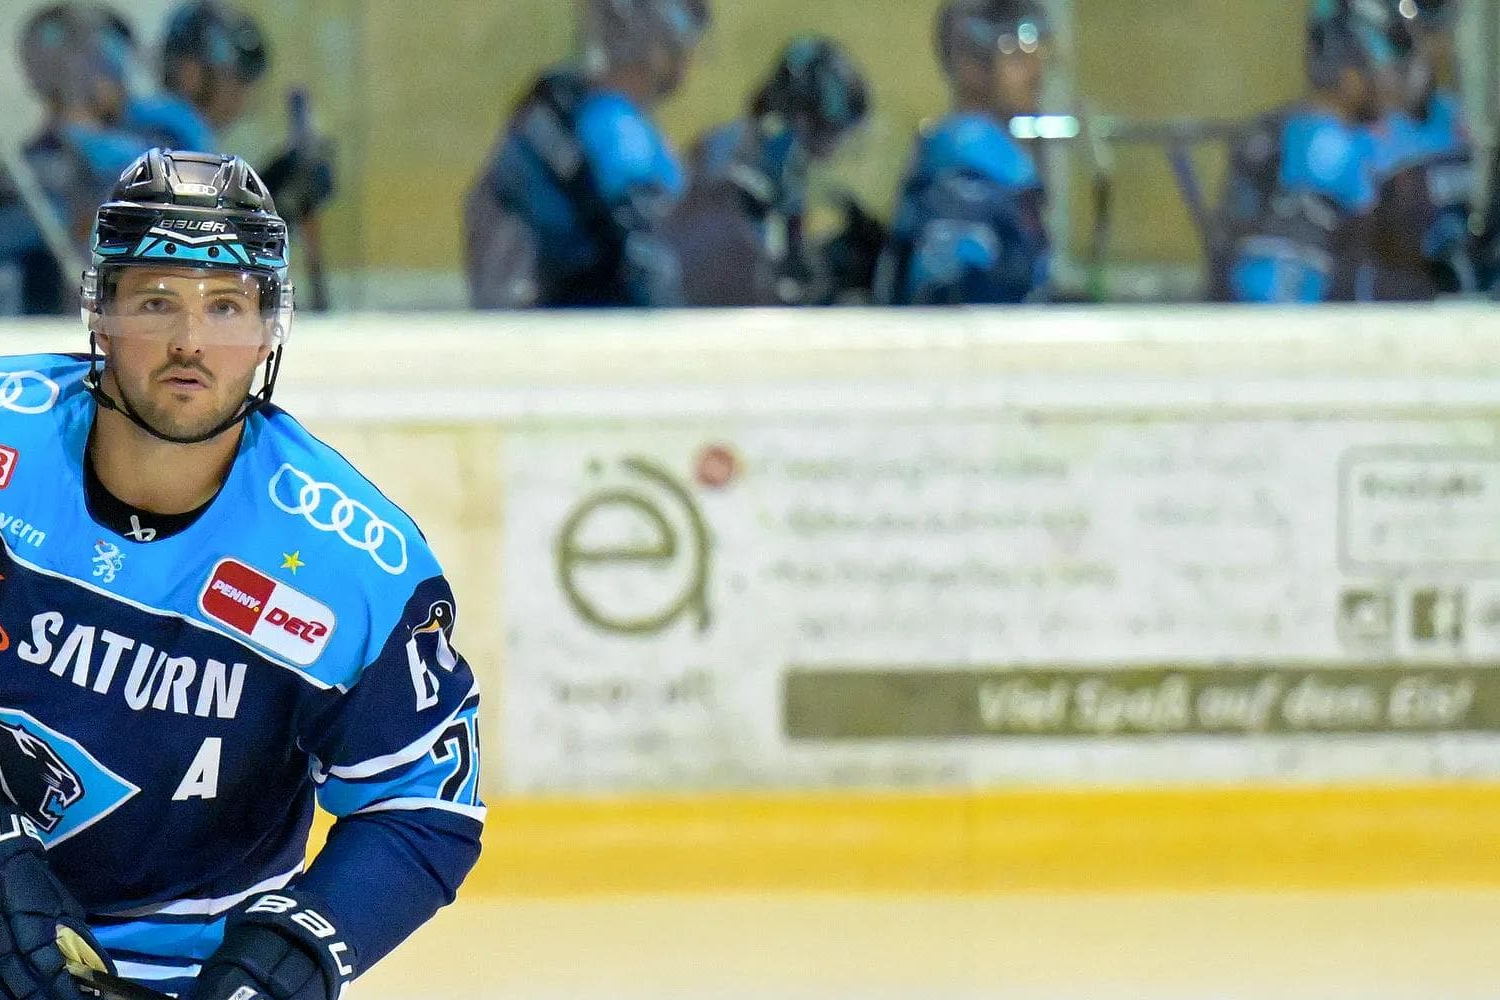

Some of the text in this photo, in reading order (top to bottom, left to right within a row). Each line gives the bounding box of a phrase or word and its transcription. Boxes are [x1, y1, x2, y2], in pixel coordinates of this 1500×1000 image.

[159, 218, 227, 233] BAUER
[17, 610, 248, 719] SATURN
[171, 736, 222, 801] A
